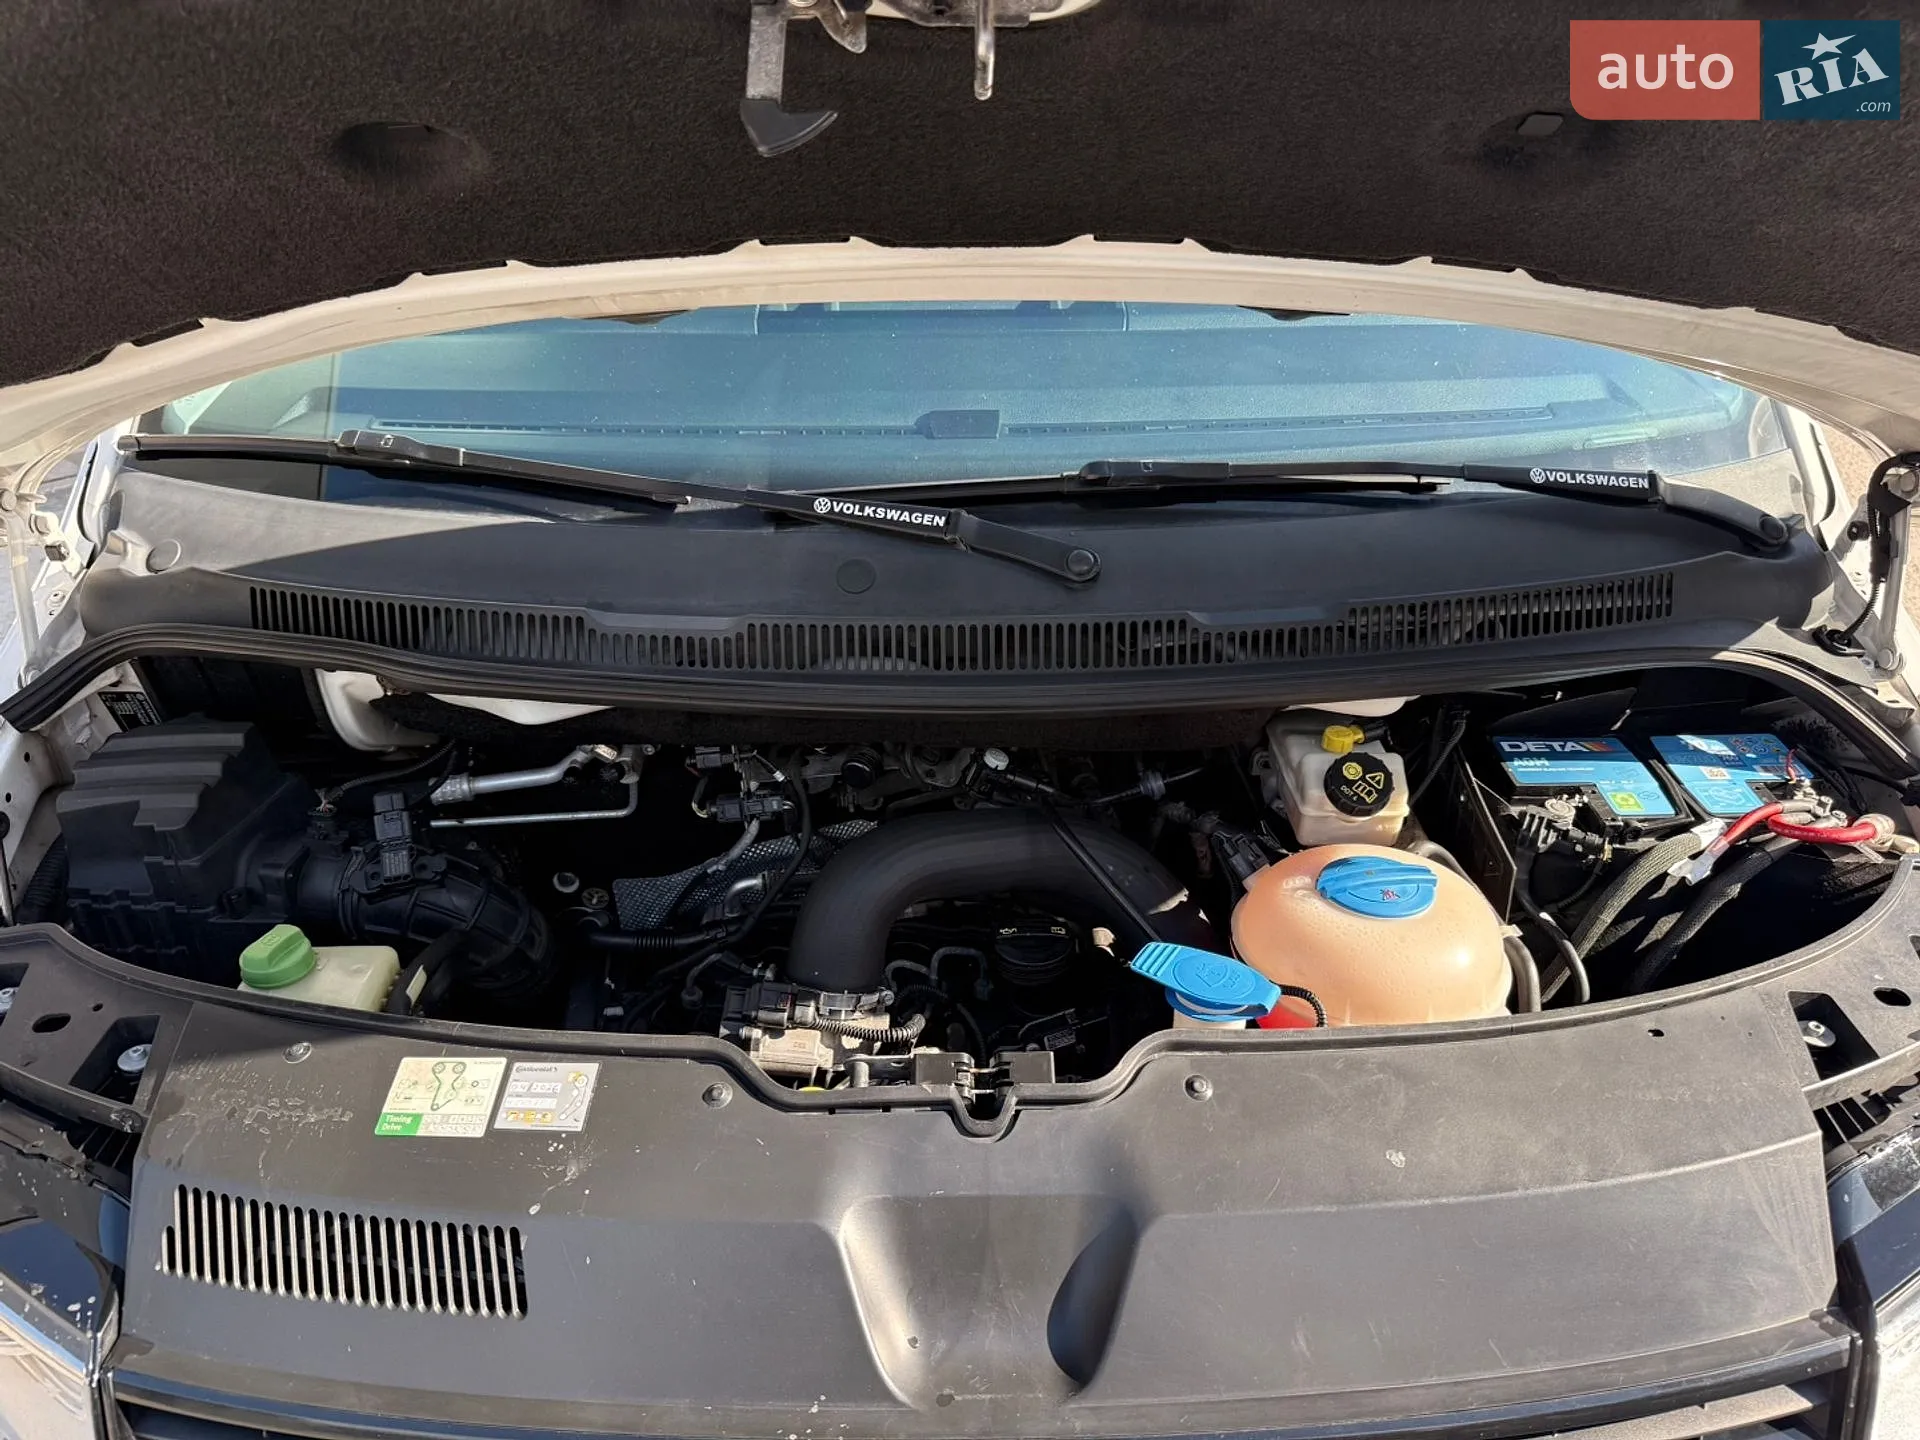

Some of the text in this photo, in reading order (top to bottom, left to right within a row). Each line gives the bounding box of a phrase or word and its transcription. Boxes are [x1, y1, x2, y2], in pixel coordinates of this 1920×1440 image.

[1545, 470, 1650, 489] VOLKSWAGEN
[832, 501, 946, 527] VOLKSWAGEN
[1500, 741, 1591, 752] DETA
[385, 1114, 413, 1125] Timing
